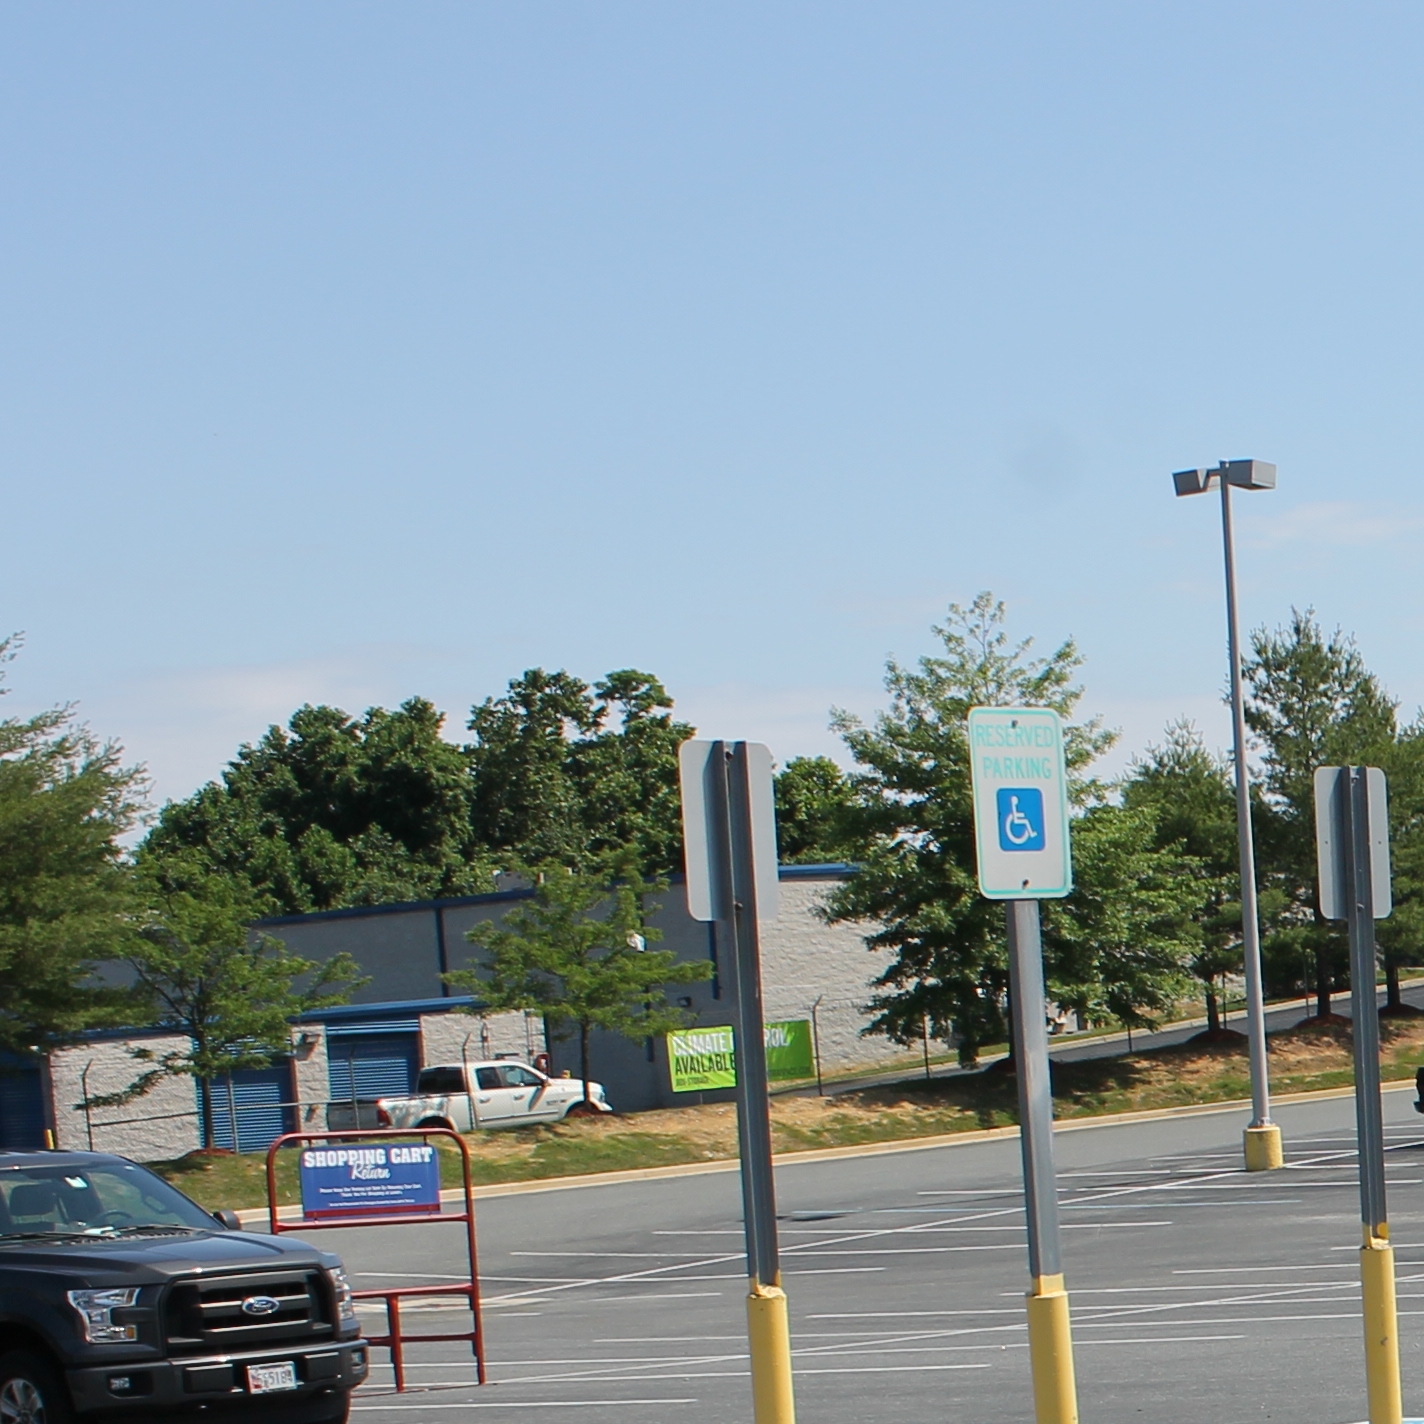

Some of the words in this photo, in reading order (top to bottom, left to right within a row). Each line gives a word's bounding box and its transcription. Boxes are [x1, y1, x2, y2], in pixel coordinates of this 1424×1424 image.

[975, 724, 1055, 748] RESERVED
[982, 756, 1052, 779] PARKING
[304, 1149, 387, 1168] SHOPPING
[390, 1146, 433, 1164] CART
[350, 1160, 391, 1180] Return
